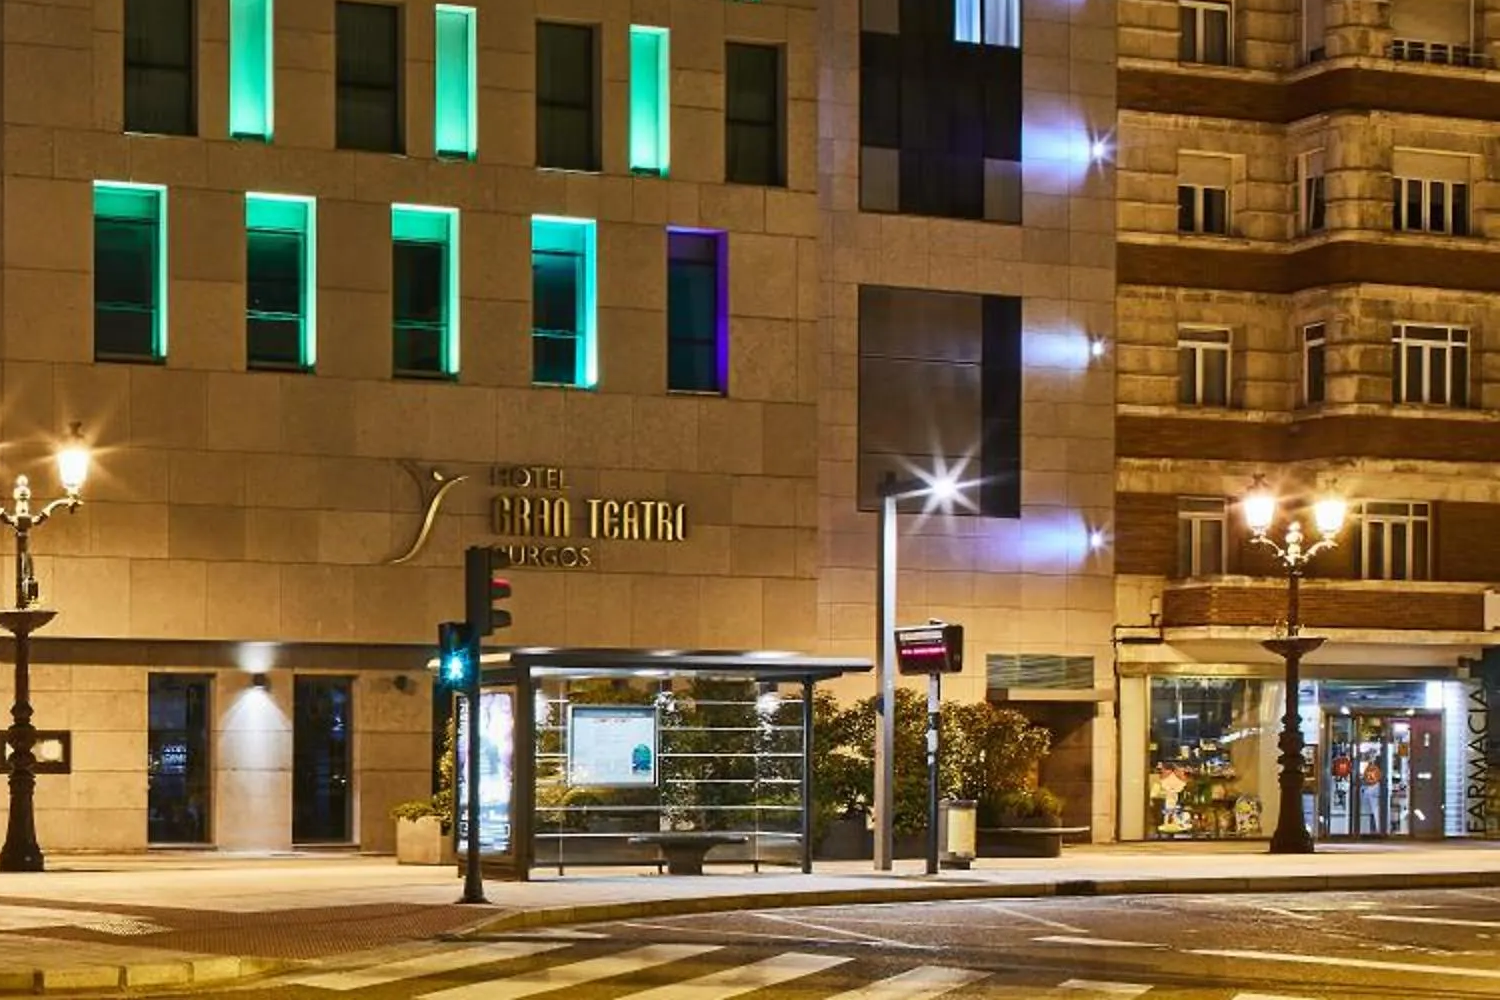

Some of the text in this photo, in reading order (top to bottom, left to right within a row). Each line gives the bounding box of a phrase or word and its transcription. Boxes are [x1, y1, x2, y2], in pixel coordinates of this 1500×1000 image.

[490, 466, 572, 490] HOTEL
[493, 496, 571, 538] GRAN
[500, 545, 592, 567] URGOS
[1466, 686, 1490, 833] FARMACIA
